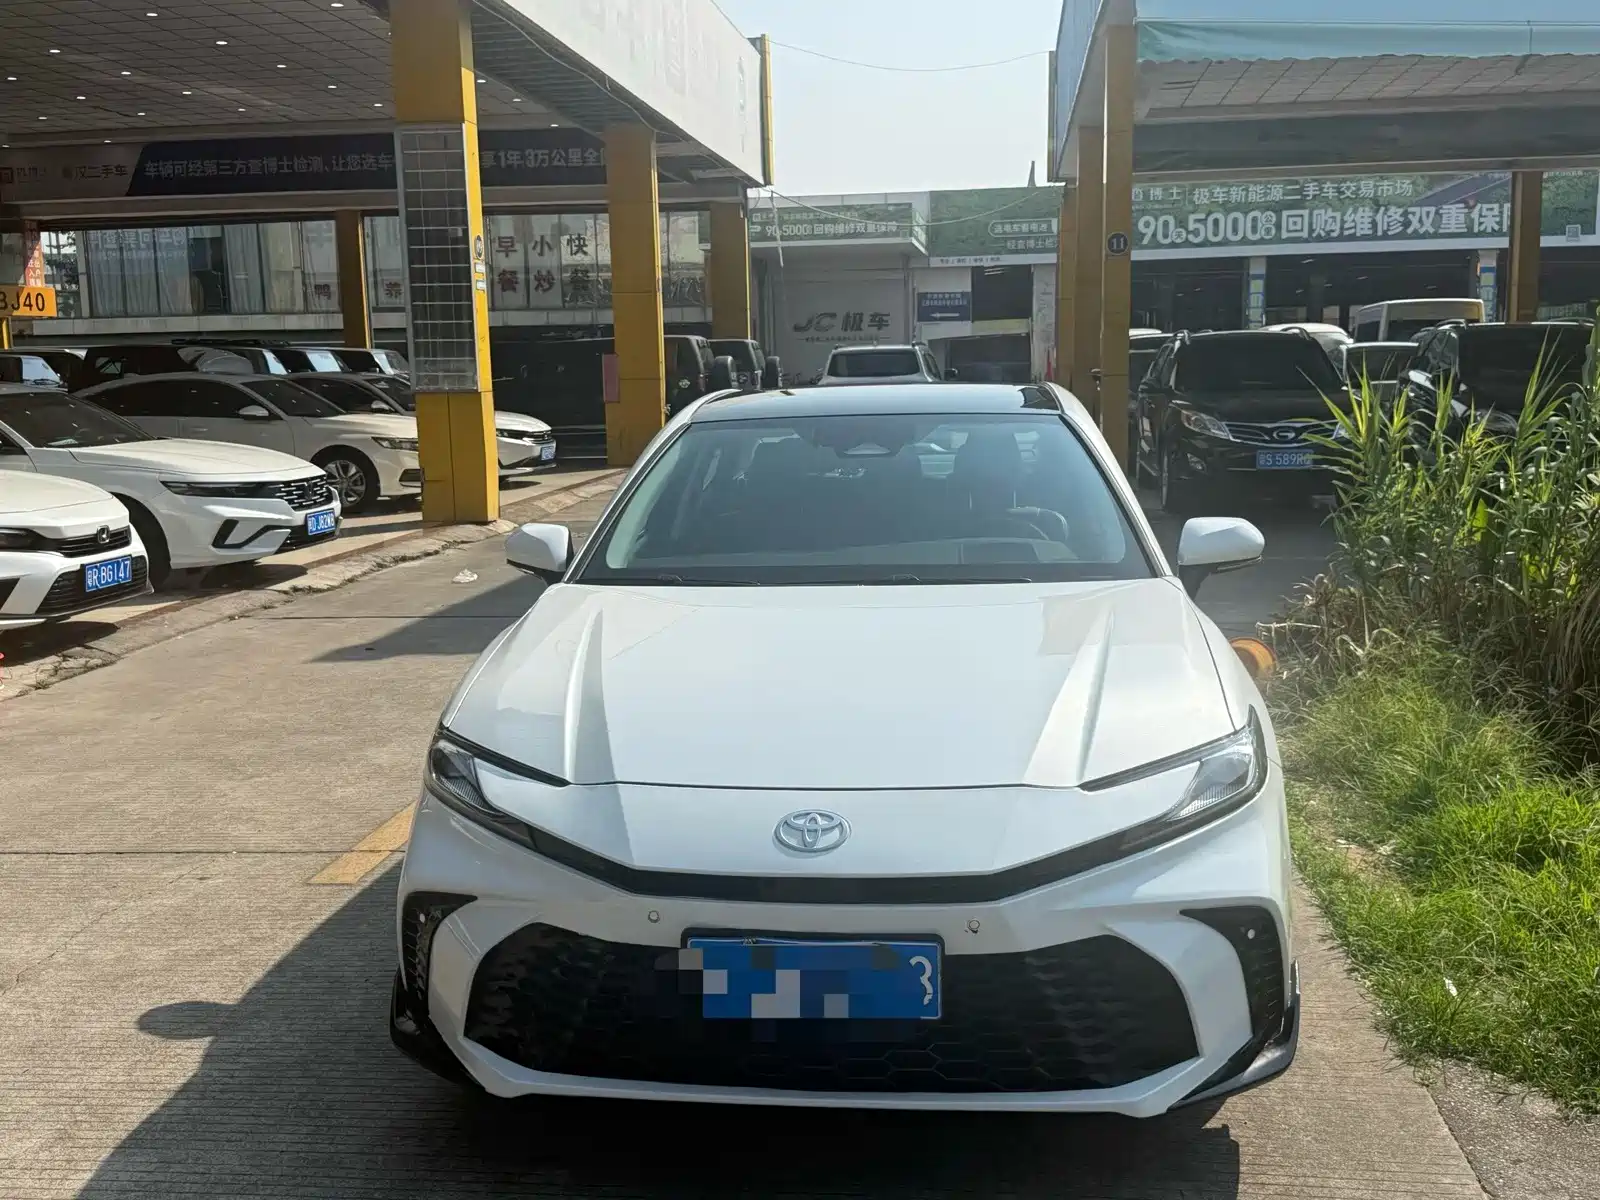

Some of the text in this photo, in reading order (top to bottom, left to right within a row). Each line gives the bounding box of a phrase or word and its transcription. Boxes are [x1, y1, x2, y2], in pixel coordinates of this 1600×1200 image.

[1193, 179, 1414, 206] 极车新能源二手车交易市场
